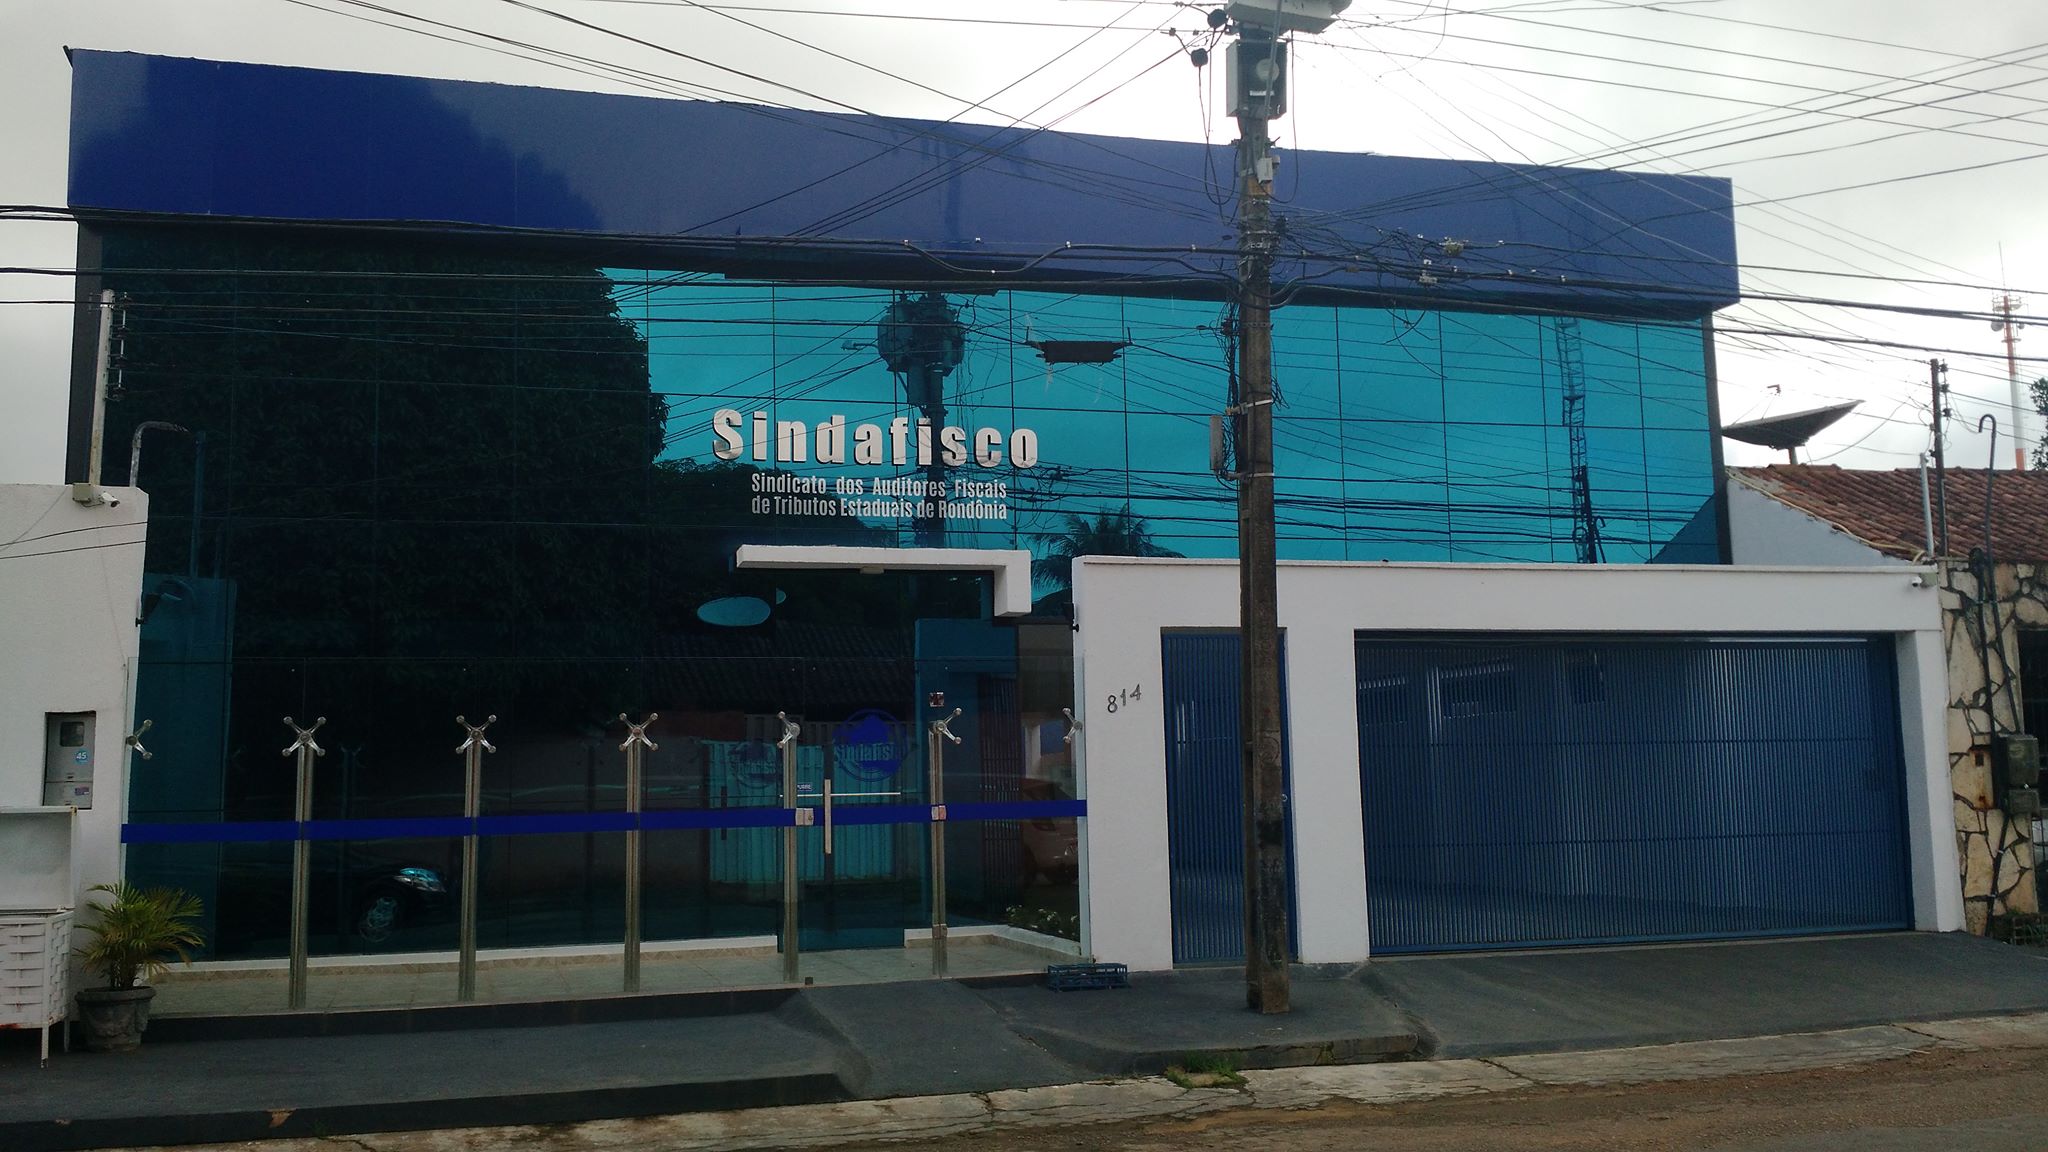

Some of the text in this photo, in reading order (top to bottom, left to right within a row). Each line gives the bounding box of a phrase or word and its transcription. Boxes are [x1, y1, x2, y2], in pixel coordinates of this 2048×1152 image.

[712, 409, 1038, 469] Sindafisco
[751, 473, 1007, 498] Sindicato dos Auditores Fiscais
[751, 495, 1007, 519] de Tributos Estaduais de Rondônia
[1107, 683, 1142, 714] 814
[76, 751, 88, 760] 45
